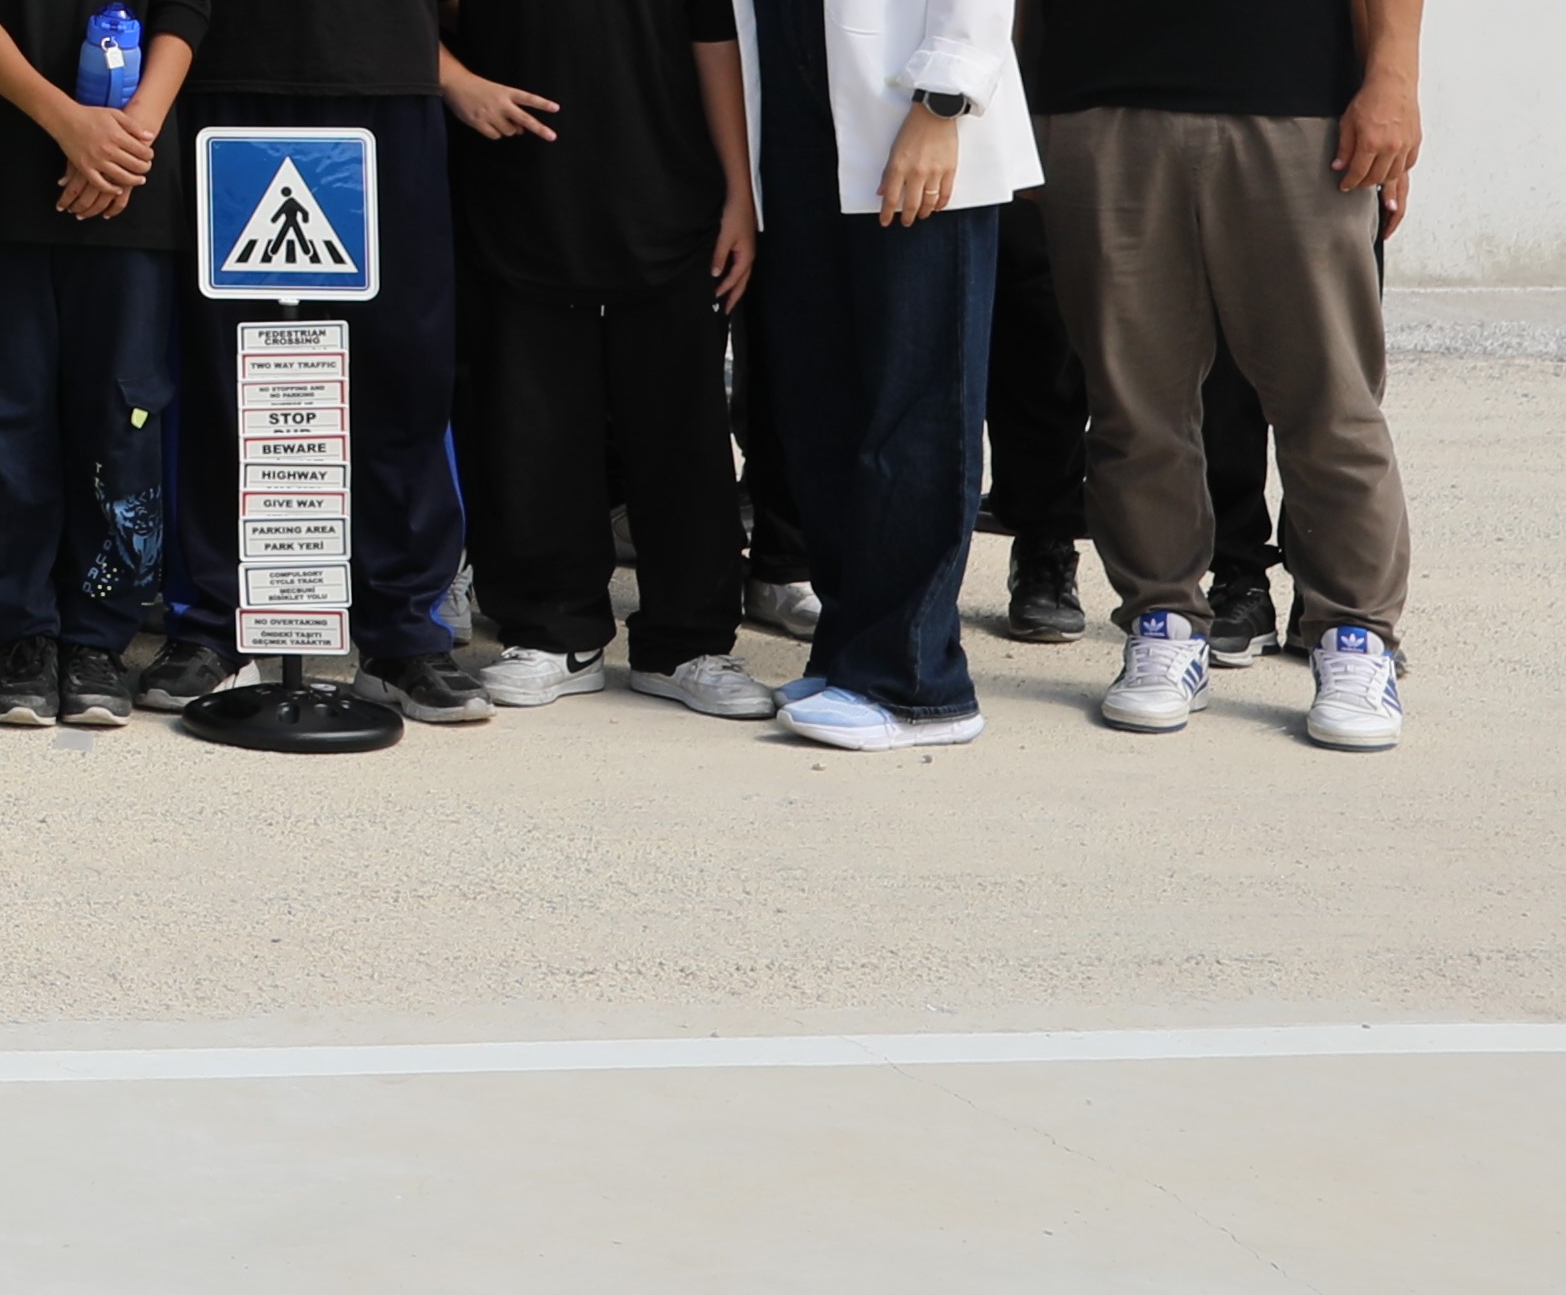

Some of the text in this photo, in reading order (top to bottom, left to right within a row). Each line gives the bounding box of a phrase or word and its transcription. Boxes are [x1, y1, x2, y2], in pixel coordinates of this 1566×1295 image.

[258, 329, 326, 338] PEDESTRIAN
[264, 337, 320, 346] CROSSING
[297, 361, 336, 369] TRAFFIC
[269, 413, 317, 425] STOP
[262, 443, 327, 454] BEWARE
[261, 470, 328, 480] HIGHWAY
[263, 499, 324, 508] GIVE WAY
[252, 525, 336, 535] PARKING AREA
[264, 541, 324, 551] PARK YERİ
